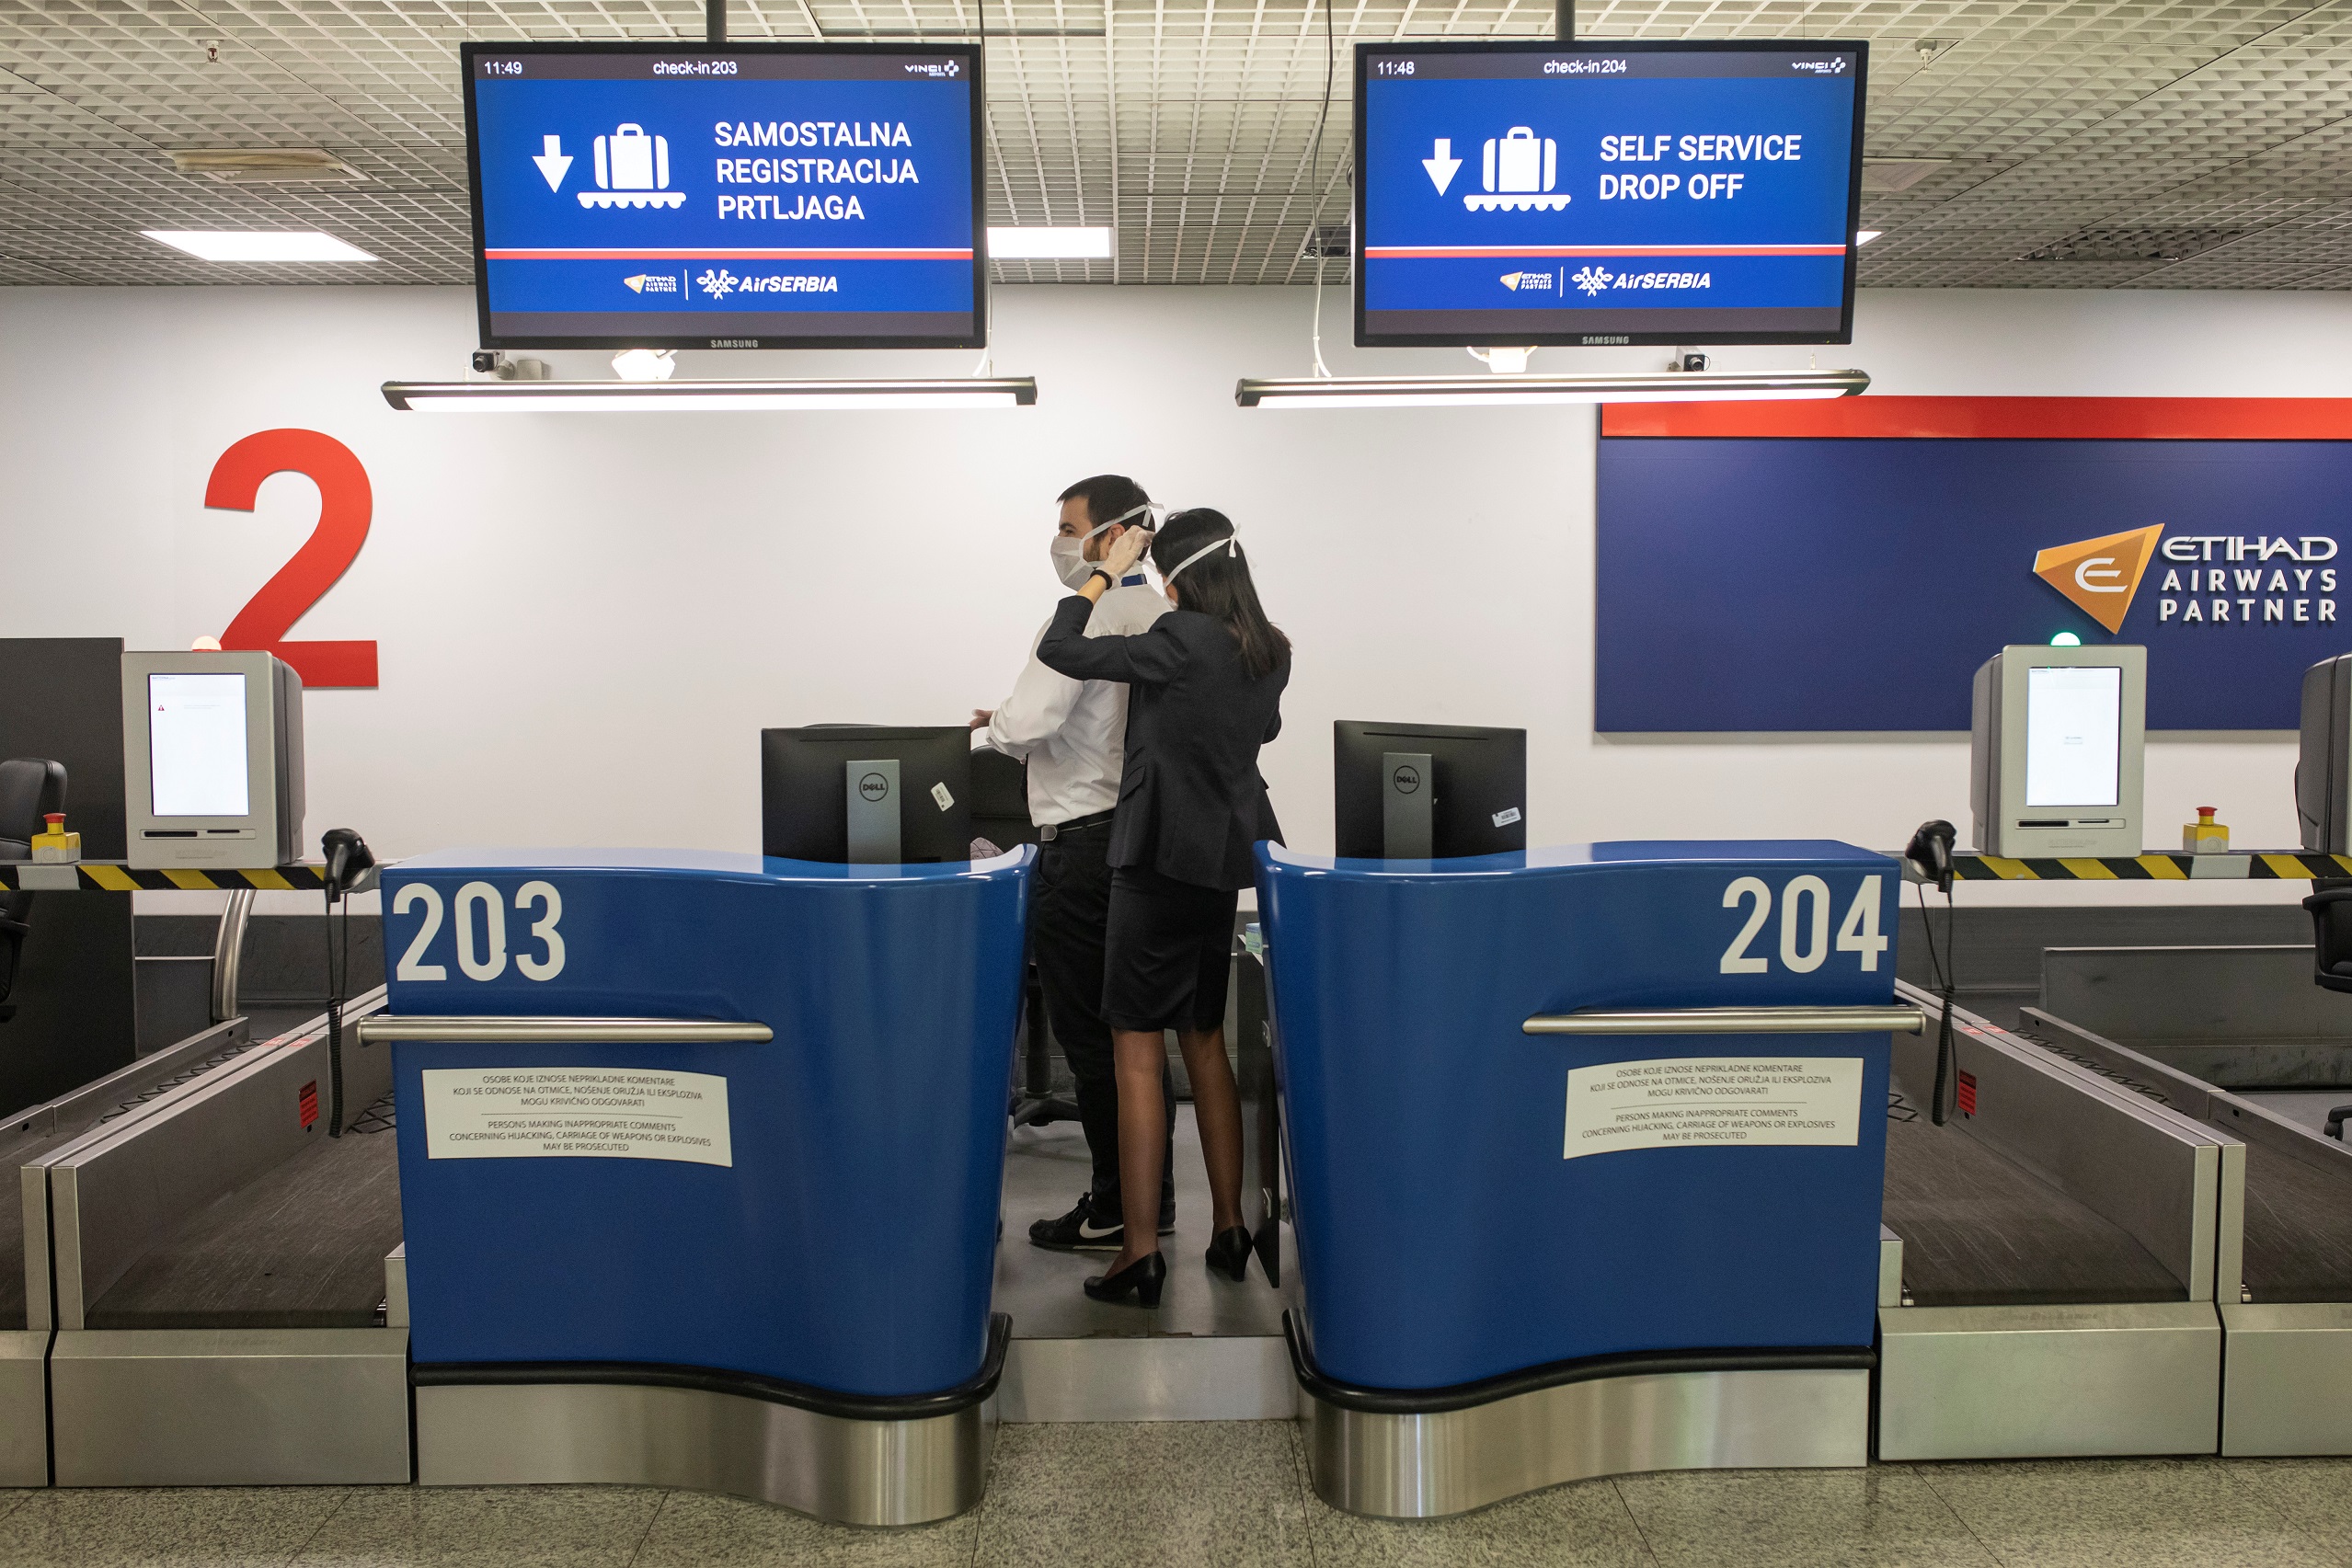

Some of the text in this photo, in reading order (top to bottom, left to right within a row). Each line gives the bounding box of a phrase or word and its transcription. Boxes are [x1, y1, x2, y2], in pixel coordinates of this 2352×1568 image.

[484, 62, 522, 74] 11:49
[653, 61, 738, 74] check-in 203
[1377, 61, 1415, 75] 11:48
[1543, 59, 1627, 74] check-in 204
[1791, 62, 1829, 70] VINCI
[715, 121, 912, 147] SAMOSTALNA
[1600, 134, 1802, 162] SELF SERVICE
[717, 158, 920, 184] REGISTRACIJA
[1599, 173, 1745, 200] DROP OFF
[717, 195, 866, 220] PRTLJAGA
[710, 339, 759, 349] SAMSUNG
[1582, 336, 1630, 345] SAMSUNG
[2162, 536, 2338, 561] ETIHAD
[204, 429, 378, 689] 2
[2161, 569, 2336, 592] AIRWAYS
[2160, 599, 2336, 622] PARTNER
[393, 880, 566, 981] 203
[1720, 875, 1887, 974] 204
[1616, 1068, 1642, 1078] OSOBE
[1644, 1067, 1663, 1075] KOJE
[1664, 1066, 1692, 1074] IZNOSE
[1695, 1065, 1750, 1073] NEPRIKLADNE
[483, 1074, 675, 1086] OSOBE KOJE IZNOSE NEPRIKLADNE KOMENTARE
[1589, 1084, 1606, 1093] KOJI
[1617, 1079, 1649, 1089] ODNOSE
[1784, 1076, 1831, 1084] EKSPLOZIVA
[658, 1089, 703, 1100] EKSPLOZIVA
[1647, 1089, 1673, 1097] MOGU
[1715, 1087, 1768, 1095] ODGOVARATI
[591, 1097, 645, 1106] ODGOVARATI
[1616, 1109, 1797, 1122] PERSONS MAKING INAPPROPRIATE COMMENTS
[528, 1120, 563, 1128] MAKING
[565, 1120, 627, 1129] INAPPROPRIATE
[630, 1121, 676, 1132] COMMENTS
[1582, 1126, 1631, 1139] CONCERNING
[1676, 1121, 1715, 1129] CARRIAGE
[1731, 1120, 1772, 1128] WEAPONS
[1787, 1120, 1835, 1128] EXPLOSIVES
[449, 1132, 506, 1140] CONCERNING
[556, 1131, 597, 1139] CARRIAGE
[612, 1132, 652, 1141] WEAPONS
[668, 1135, 712, 1147] EXPLOSIVES
[1663, 1133, 1680, 1141] MAY
[1693, 1131, 1747, 1139] PROSECUTED
[544, 1142, 629, 1151] MAY BE PROSECUTED
